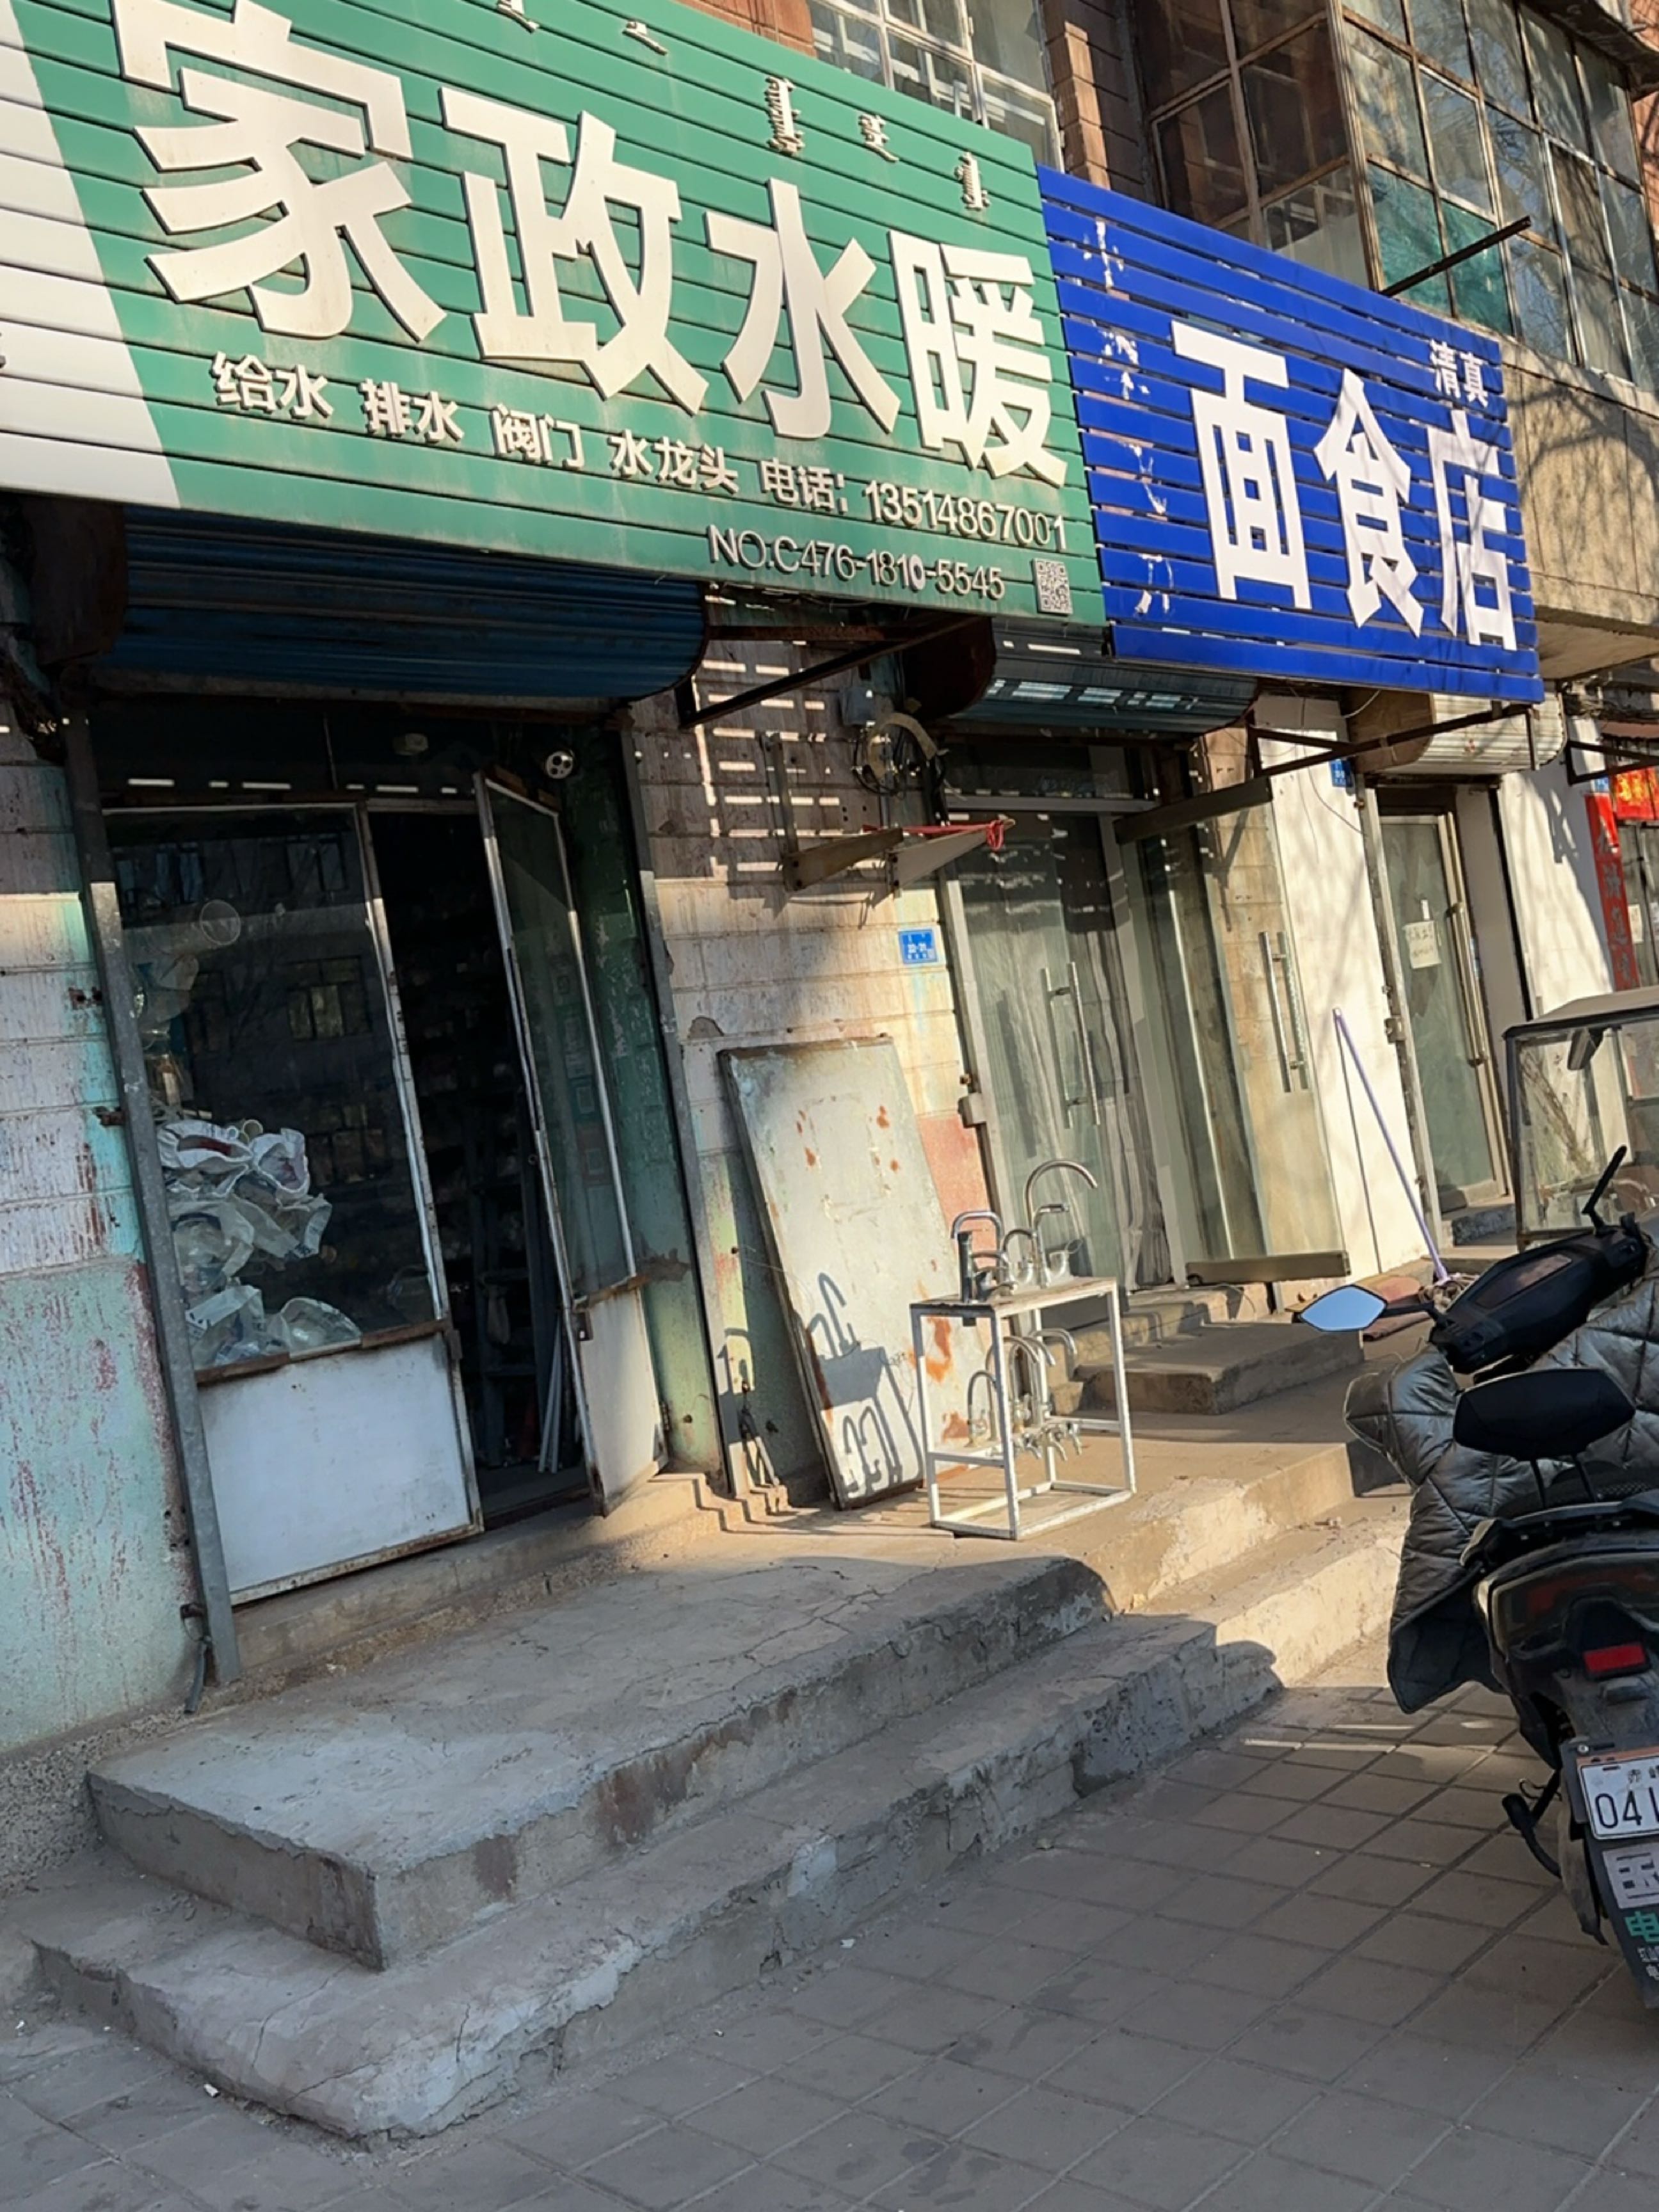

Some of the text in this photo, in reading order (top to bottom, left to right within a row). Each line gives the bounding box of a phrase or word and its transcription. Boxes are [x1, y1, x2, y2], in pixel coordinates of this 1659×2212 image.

[109, 0, 1069, 488] 家政水暖
[210, 351, 335, 419] 给水
[360, 378, 464, 442] 排水
[492, 403, 585, 469] 阀门
[607, 428, 739, 493] 水龙头
[864, 479, 1068, 552] 13514867001
[1429, 338, 1488, 408] 清真
[1171, 320, 1518, 652] 面食店
[1595, 1786, 1659, 1829] 04
